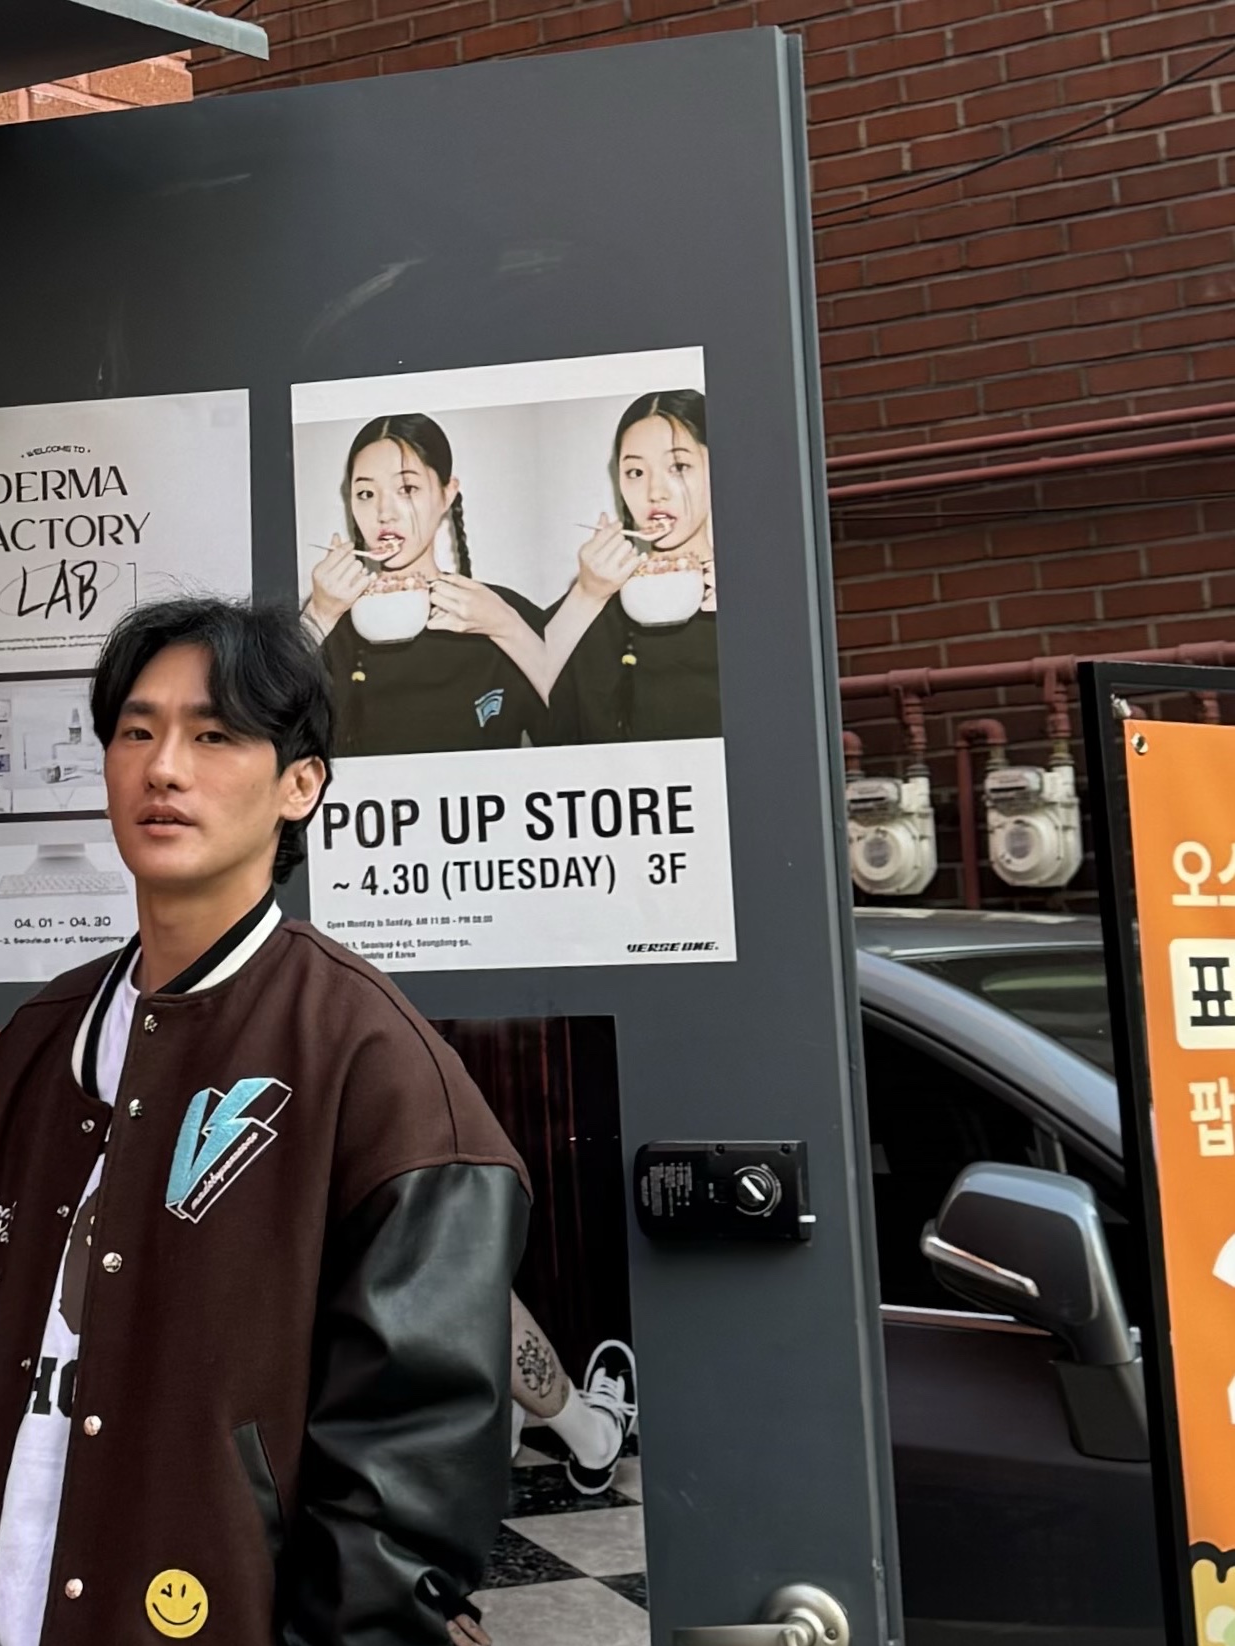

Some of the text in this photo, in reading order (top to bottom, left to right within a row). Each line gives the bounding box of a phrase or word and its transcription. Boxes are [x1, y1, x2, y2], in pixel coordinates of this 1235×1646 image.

[17, 558, 98, 620] LAB
[322, 785, 695, 850] POP UP STORE
[360, 862, 429, 896] 4.30
[442, 853, 616, 900] (TUESDAY)
[647, 852, 687, 885] 3F
[1189, 1076, 1235, 1157] 팝
